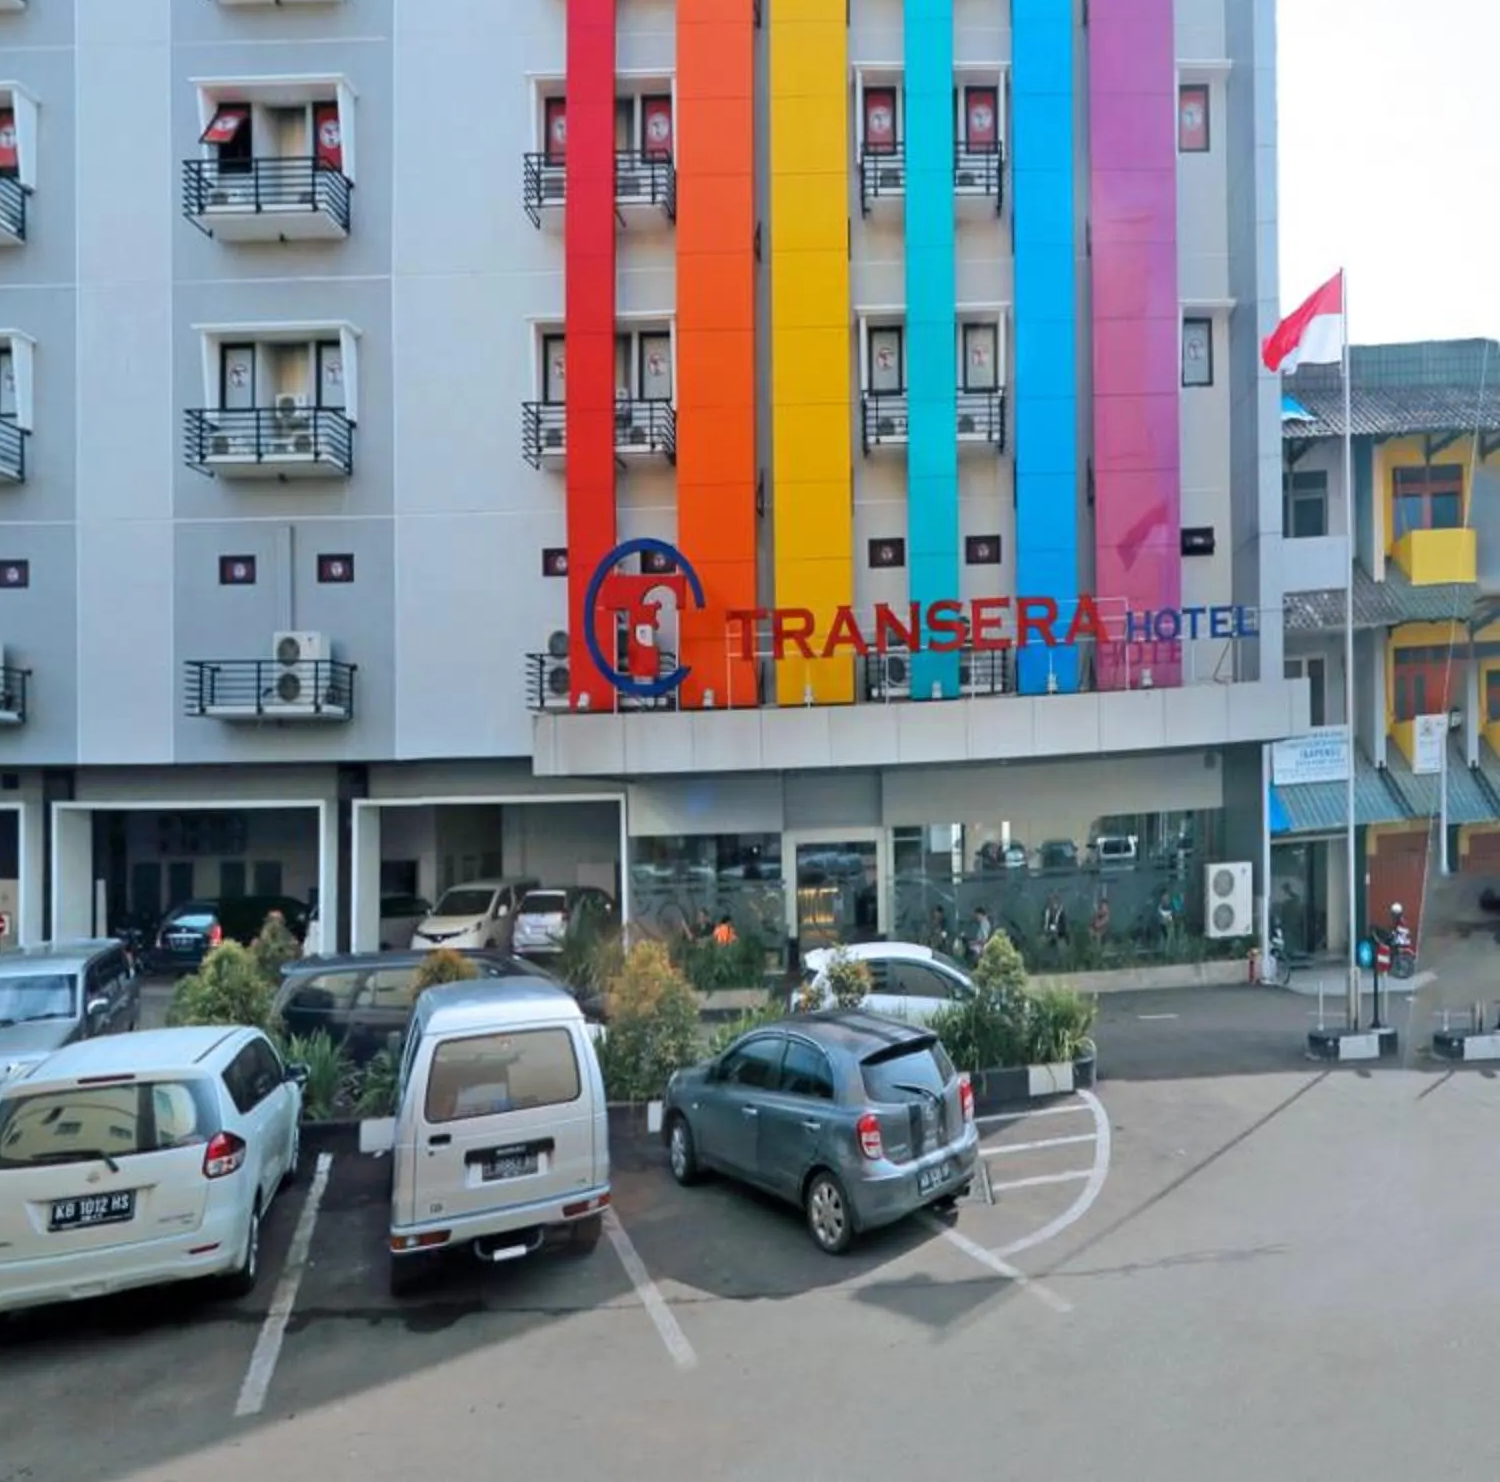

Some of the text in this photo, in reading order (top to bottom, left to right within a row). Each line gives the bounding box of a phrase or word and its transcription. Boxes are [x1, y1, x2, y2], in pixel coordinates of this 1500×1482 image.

[725, 592, 1261, 663] TRANSERA HOTEL
[55, 1203, 76, 1221] KB
[80, 1196, 109, 1216] 1012
